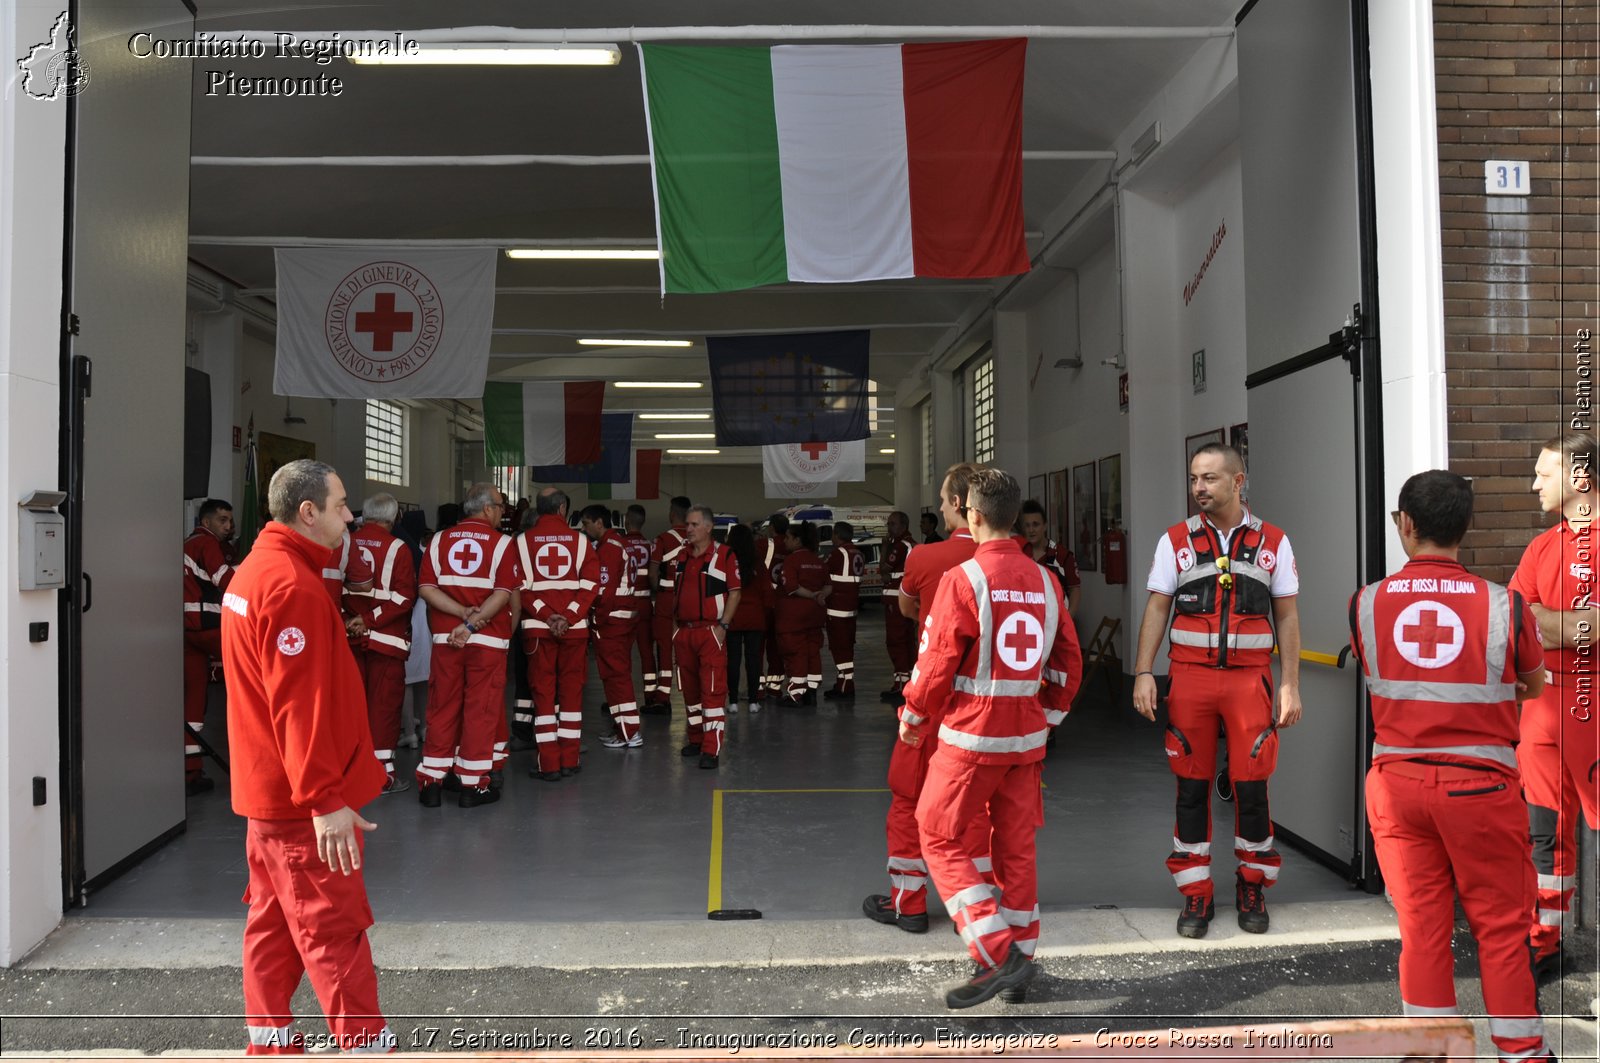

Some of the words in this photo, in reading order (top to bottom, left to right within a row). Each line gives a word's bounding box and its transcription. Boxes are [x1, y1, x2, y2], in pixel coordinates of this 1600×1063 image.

[1497, 166, 1521, 188] 31
[346, 276, 363, 294] DI
[362, 266, 420, 292] GINEVRA
[418, 289, 434, 305] 22
[330, 290, 374, 376] CONVENZIONE
[413, 307, 439, 358] AGOSTO
[390, 354, 416, 376] 1864
[991, 590, 1009, 602] CROCE
[1009, 590, 1024, 603] ROSSA
[1387, 579, 1410, 593] CROCE
[1412, 578, 1438, 592] ROSSA
[1440, 579, 1476, 594] ITALIANA
